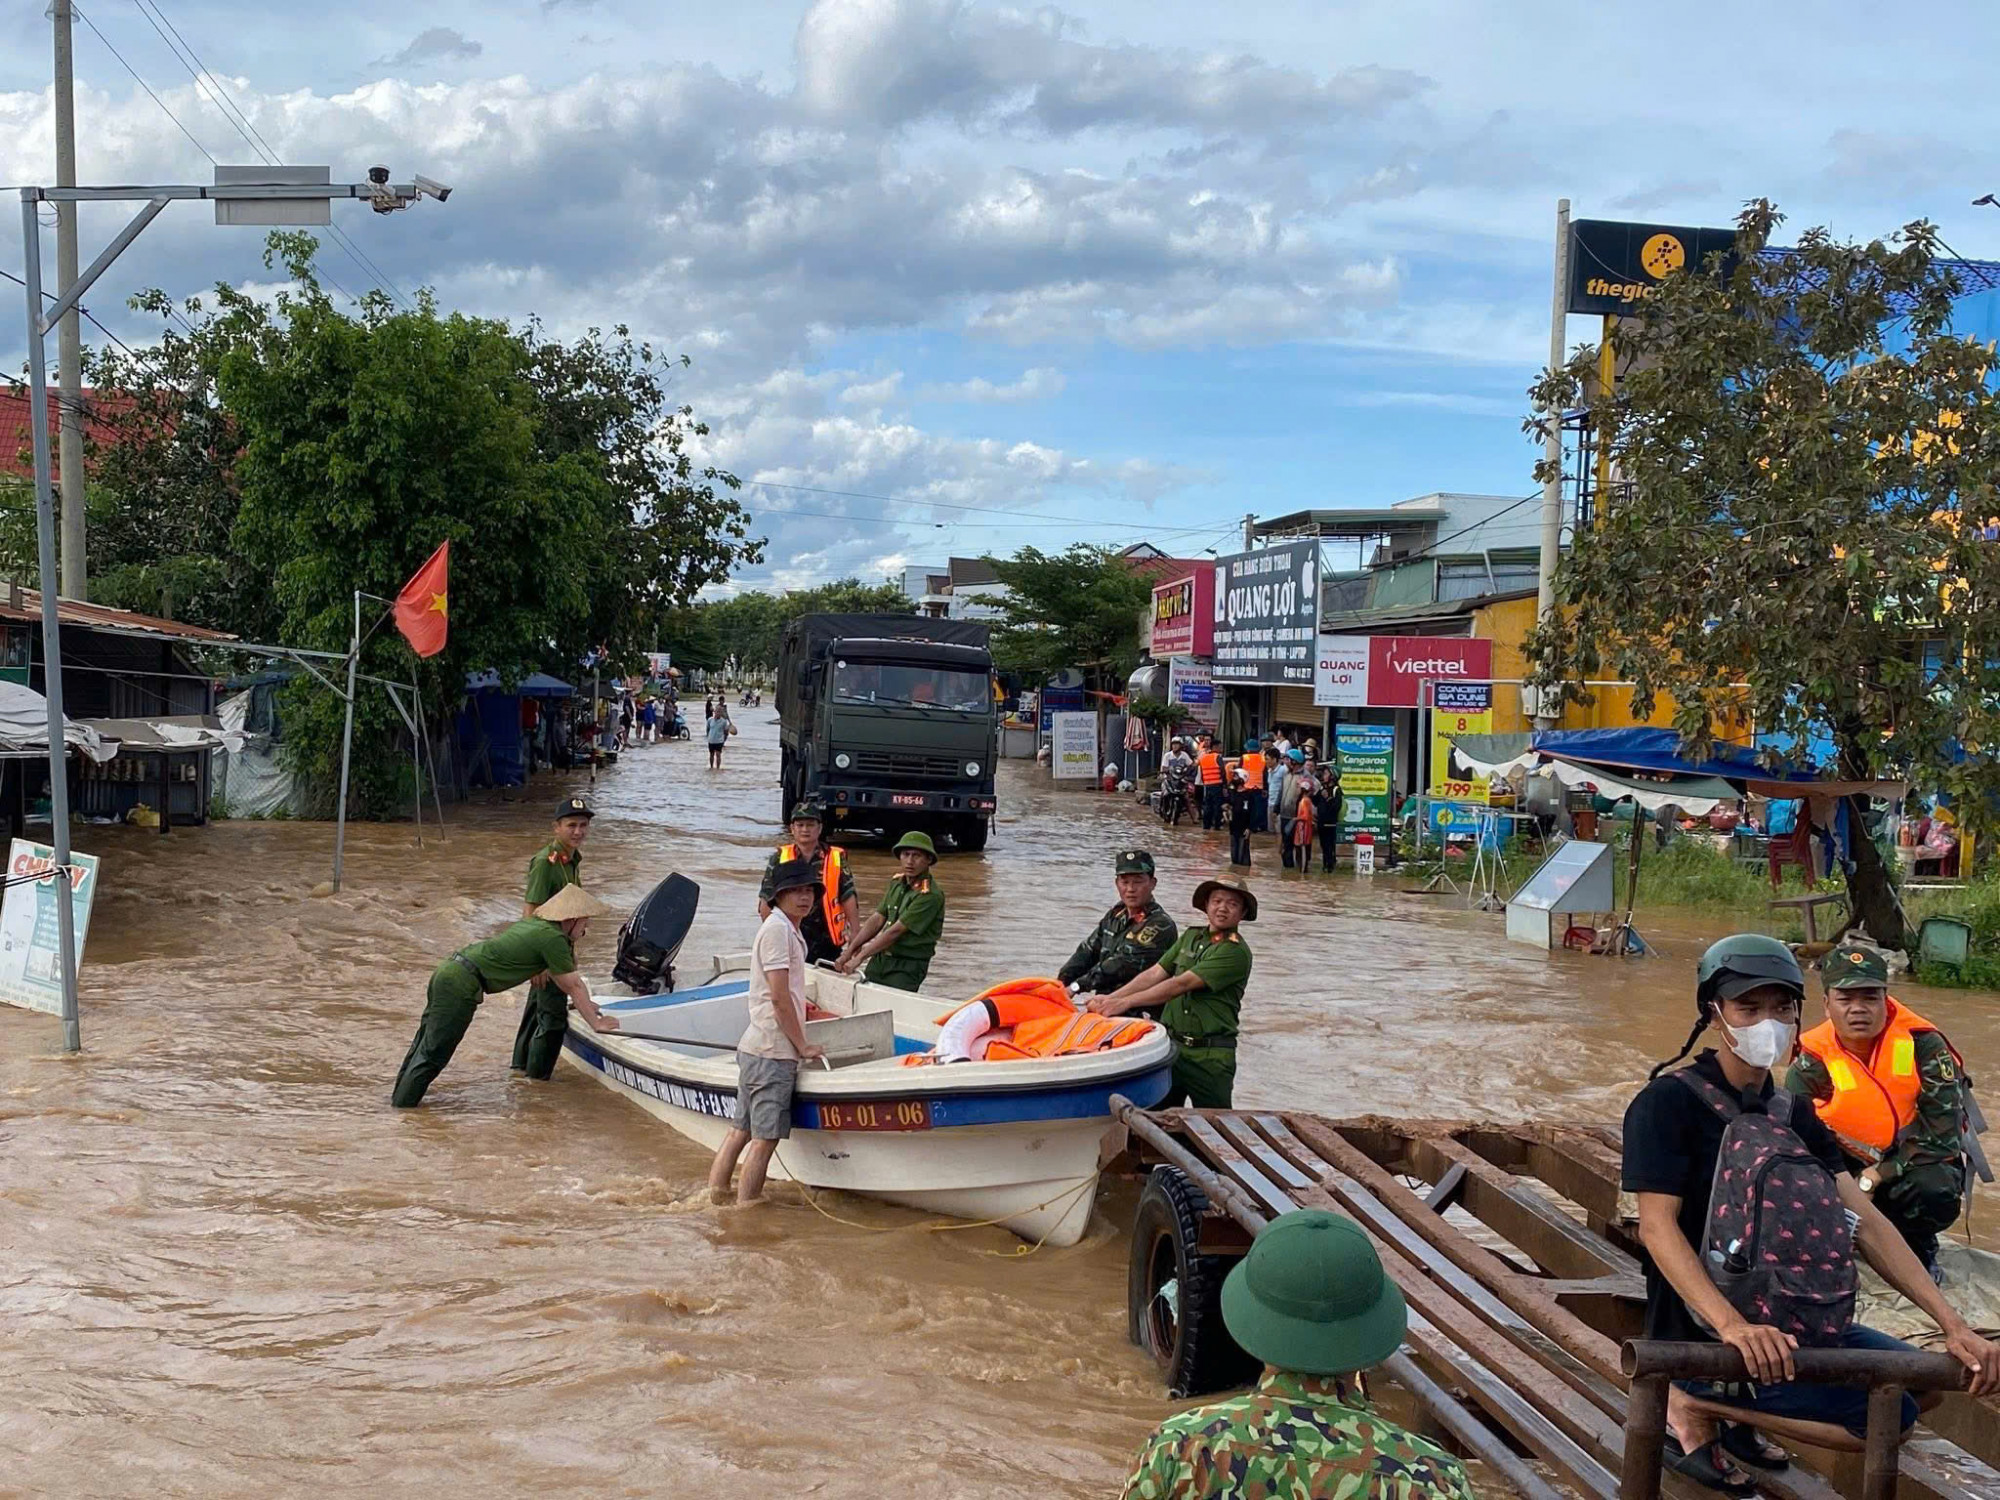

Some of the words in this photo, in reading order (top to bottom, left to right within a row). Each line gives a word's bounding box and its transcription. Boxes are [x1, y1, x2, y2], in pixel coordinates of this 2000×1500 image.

[1228, 585, 1270, 627] QUANG
[1273, 575, 1296, 626] LỢI
[1320, 660, 1365, 671] QUANG
[1393, 658, 1468, 675] viettel
[1331, 673, 1352, 686] LỢI
[1457, 718, 1467, 731] 8
[1343, 755, 1387, 766] Kangaroo
[1360, 851, 1371, 860] H7
[822, 1105, 841, 1127] 16
[857, 1105, 879, 1127] 01
[898, 1102, 924, 1125] 06
